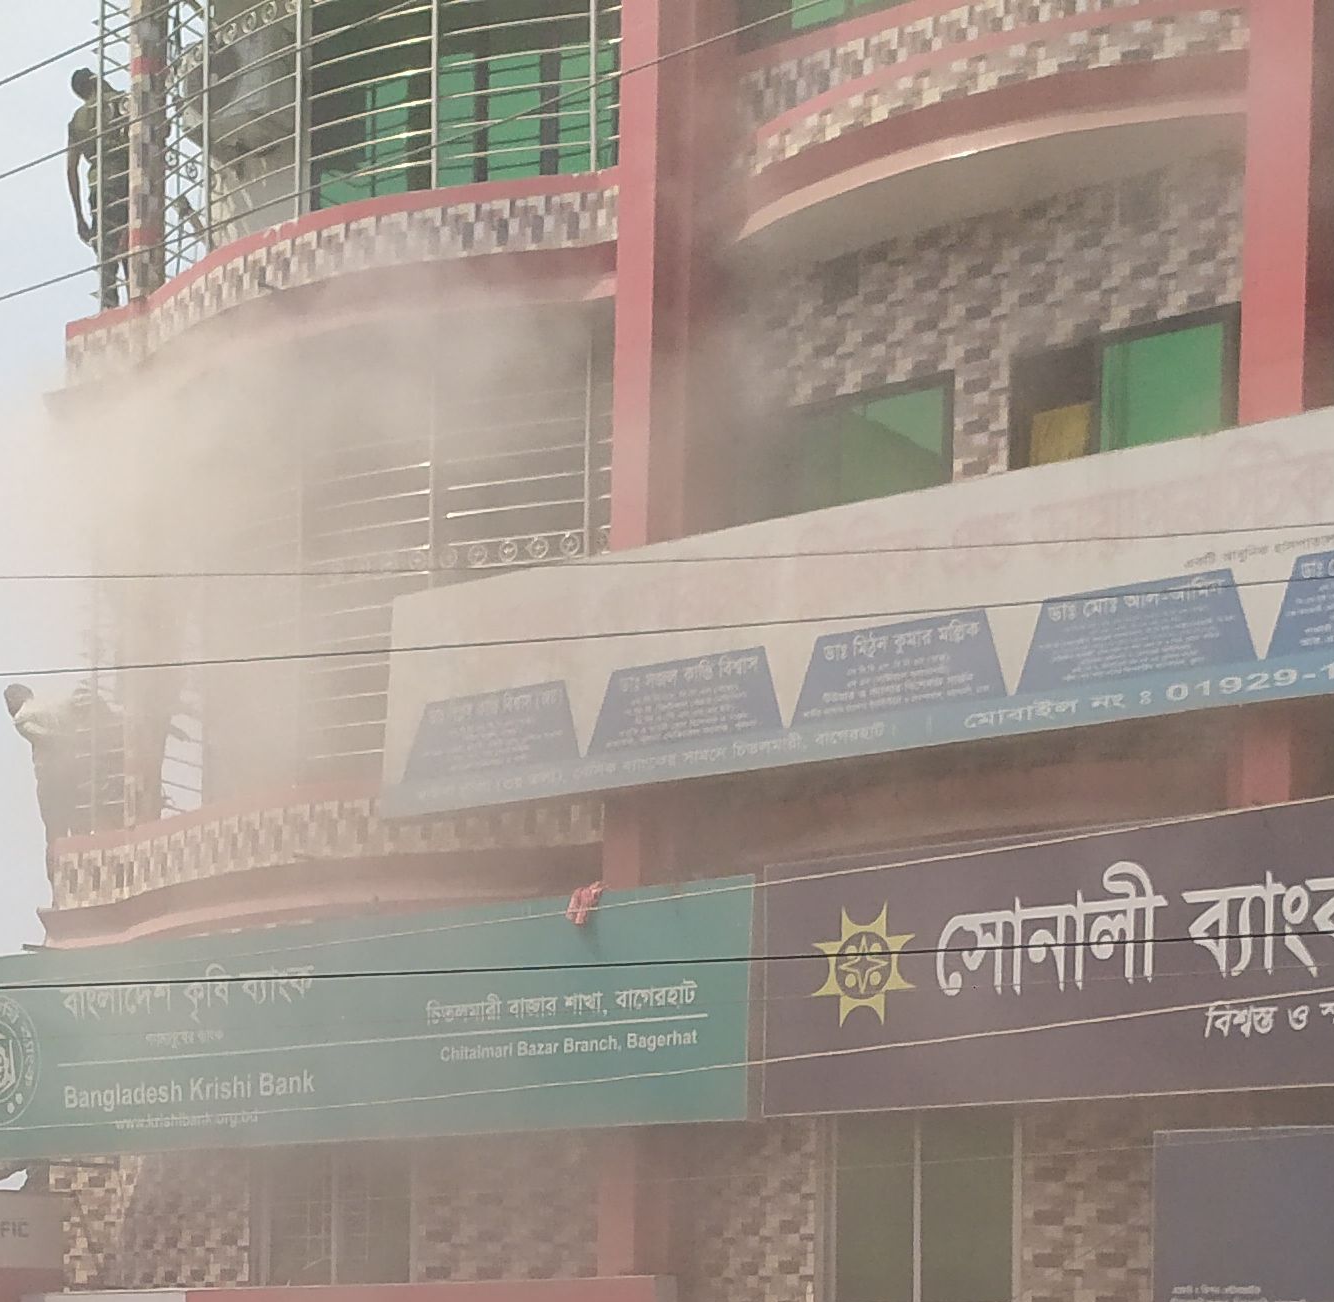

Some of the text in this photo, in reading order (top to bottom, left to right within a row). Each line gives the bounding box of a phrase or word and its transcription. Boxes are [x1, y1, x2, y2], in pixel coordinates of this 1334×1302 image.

[963, 695, 1081, 730] মোবাইল
[1091, 693, 1127, 710] নং
[936, 861, 1167, 997] সোনালী
[60, 963, 316, 1022] বাংলাদেশ কৃষি ব্যাংক
[426, 993, 502, 1025] চিতলমারী
[508, 996, 558, 1019] বাজার
[616, 979, 698, 1011] বাগেরহাট
[1205, 999, 1276, 1038] বিশ্বস্ত
[1288, 1006, 1310, 1032] ও
[517, 1041, 559, 1057] Bazar
[564, 1036, 622, 1054] Branch,
[627, 1029, 698, 1052] Bagerhat
[63, 1069, 316, 1112] Bangladesh Krishi Bank
